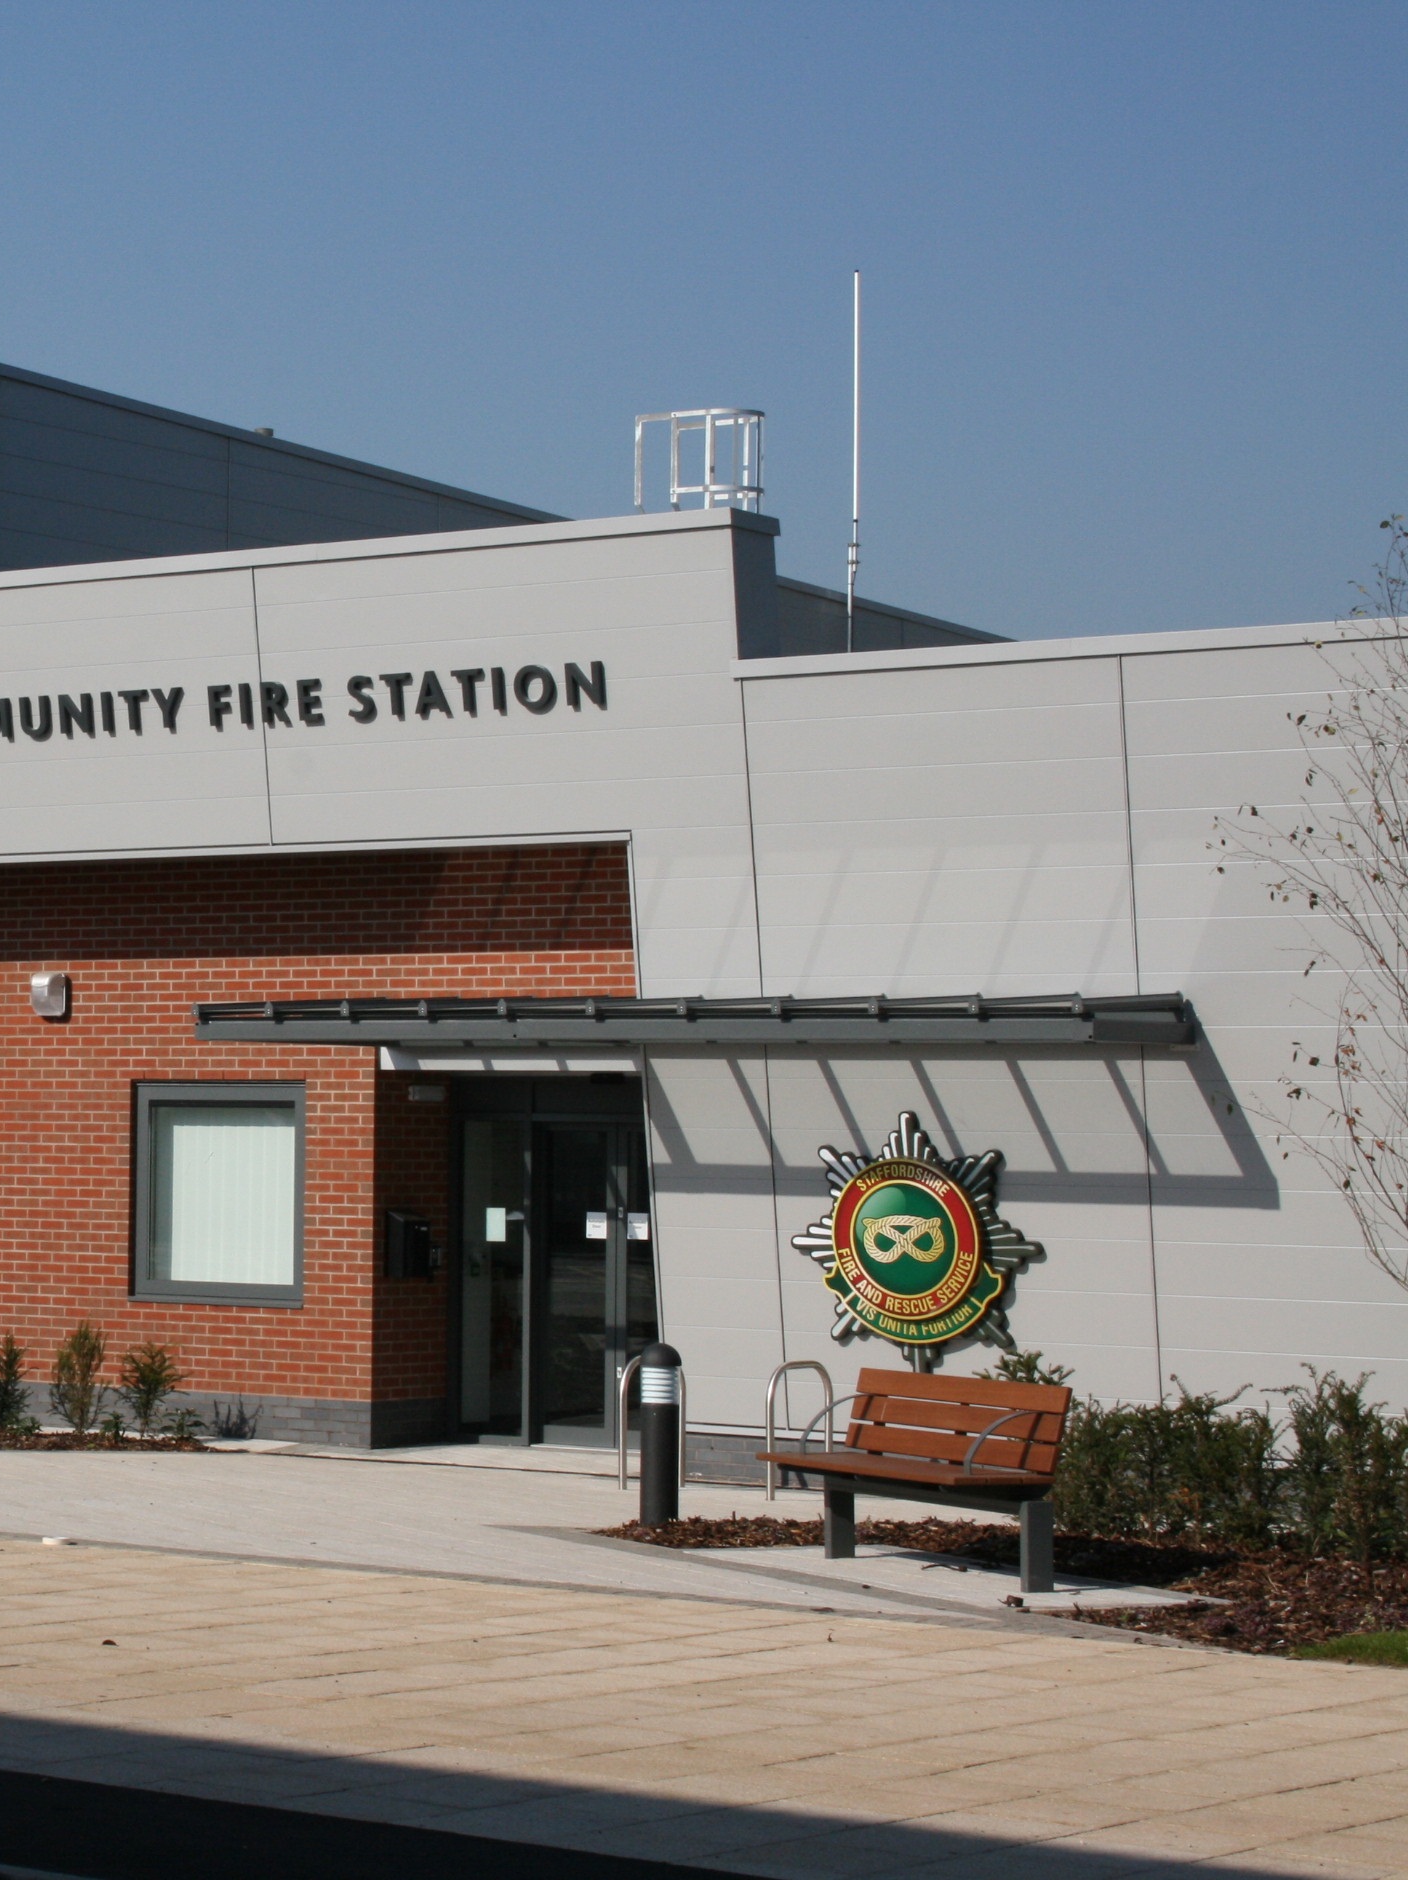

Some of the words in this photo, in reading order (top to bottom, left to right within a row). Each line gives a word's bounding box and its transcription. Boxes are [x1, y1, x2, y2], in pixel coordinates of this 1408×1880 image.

[207, 677, 325, 732] FIRE
[346, 660, 608, 725] STATION
[856, 1164, 950, 1197] STAFFORDSHIRE
[837, 1247, 861, 1281] FIRE
[855, 1279, 883, 1304] AND
[885, 1296, 937, 1314] RESCUE
[936, 1251, 973, 1304] SERVICE
[856, 1297, 877, 1321] VIS
[878, 1314, 918, 1337] UNITA
